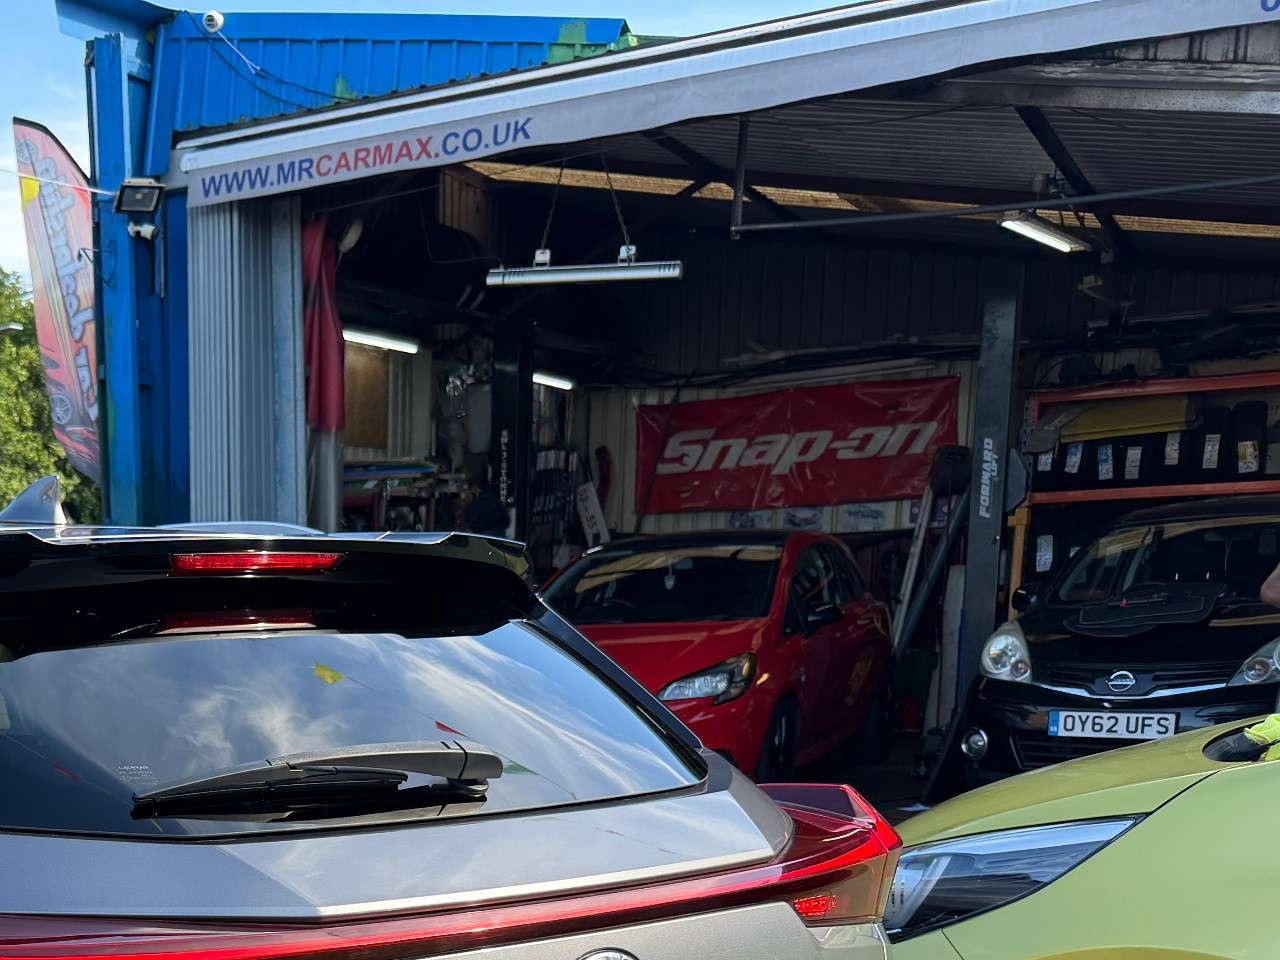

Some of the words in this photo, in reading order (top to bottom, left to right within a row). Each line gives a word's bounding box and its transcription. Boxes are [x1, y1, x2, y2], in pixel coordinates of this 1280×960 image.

[202, 117, 532, 198] WWW.MRCARMAX.CO.UK
[655, 421, 938, 475] Snap-on
[1063, 714, 1119, 734] OY62
[1126, 716, 1170, 735] UFS
